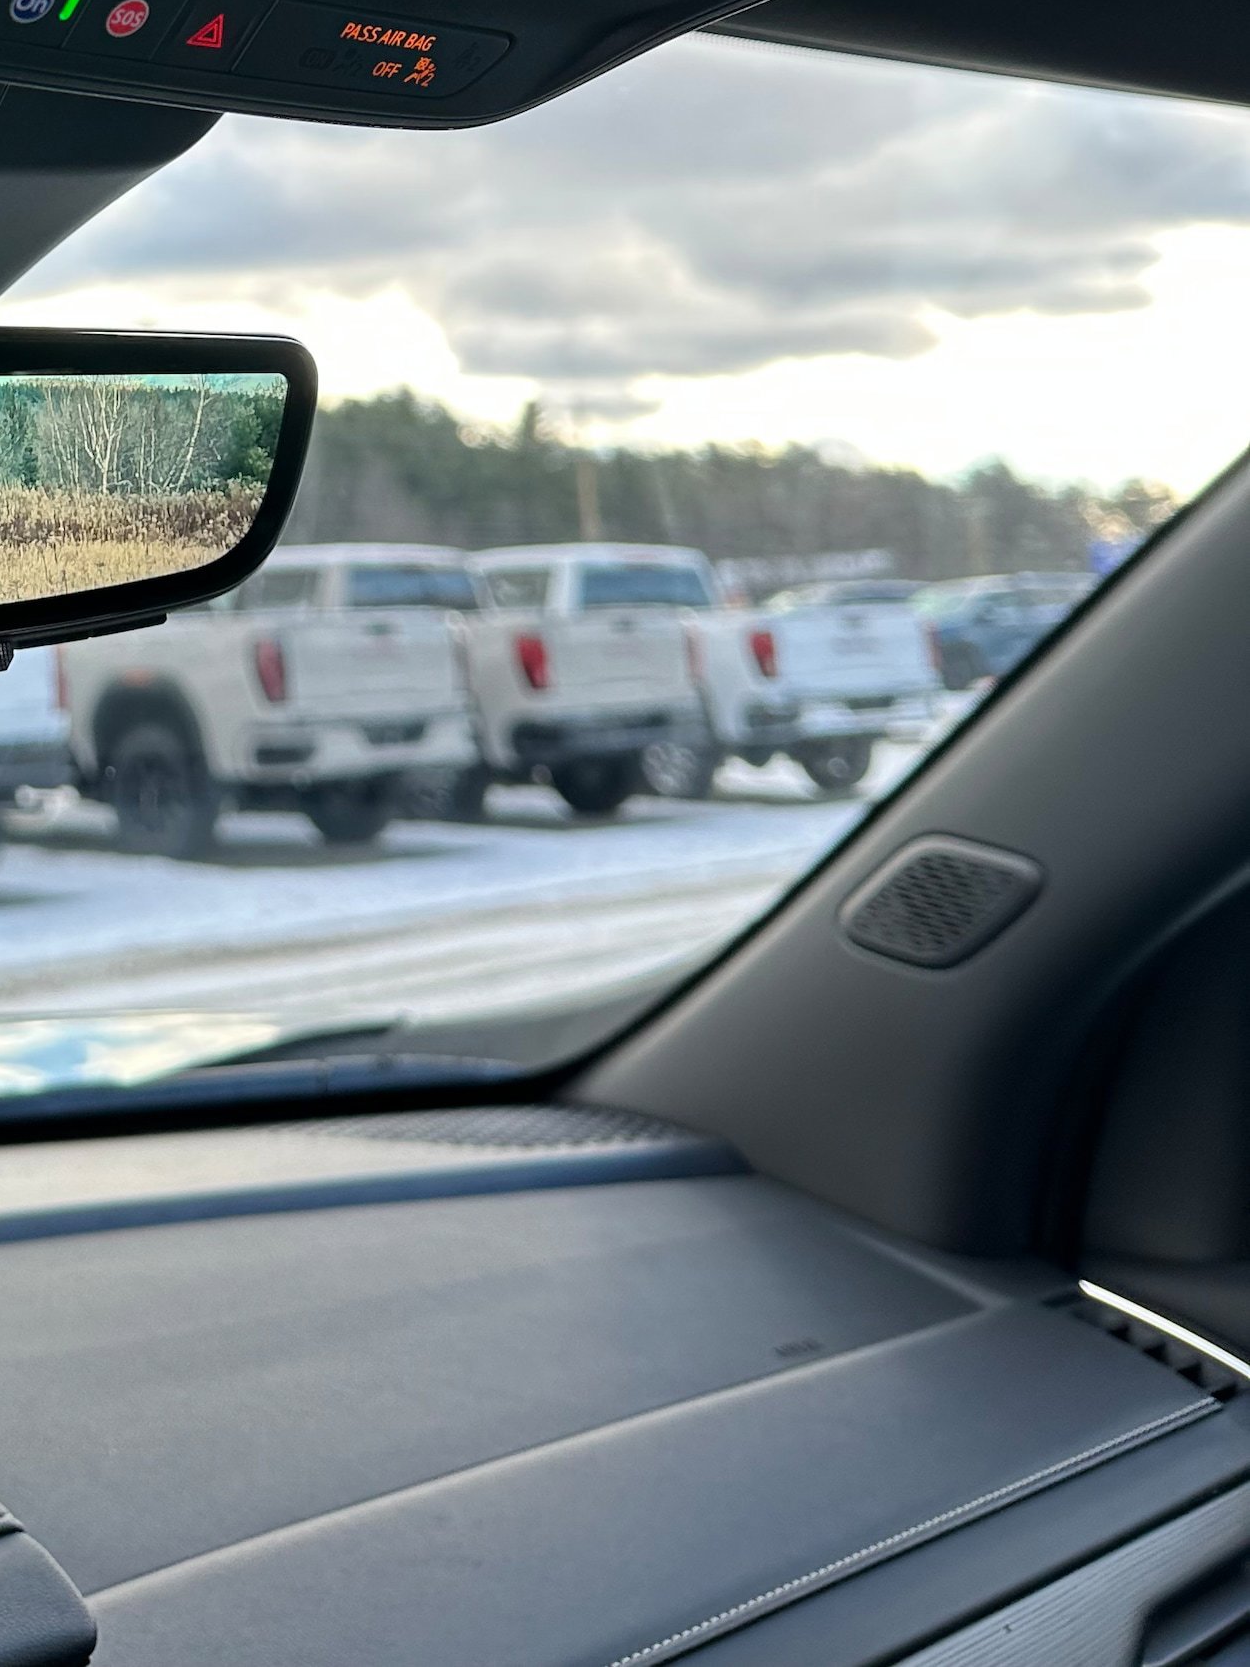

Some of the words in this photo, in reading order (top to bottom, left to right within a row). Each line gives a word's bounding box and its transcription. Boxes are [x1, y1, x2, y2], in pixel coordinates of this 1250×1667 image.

[111, 9, 145, 27] SOS
[340, 22, 381, 43] PASS
[377, 29, 406, 47] AIR
[404, 33, 437, 52] BAG
[372, 61, 402, 78] OFF
